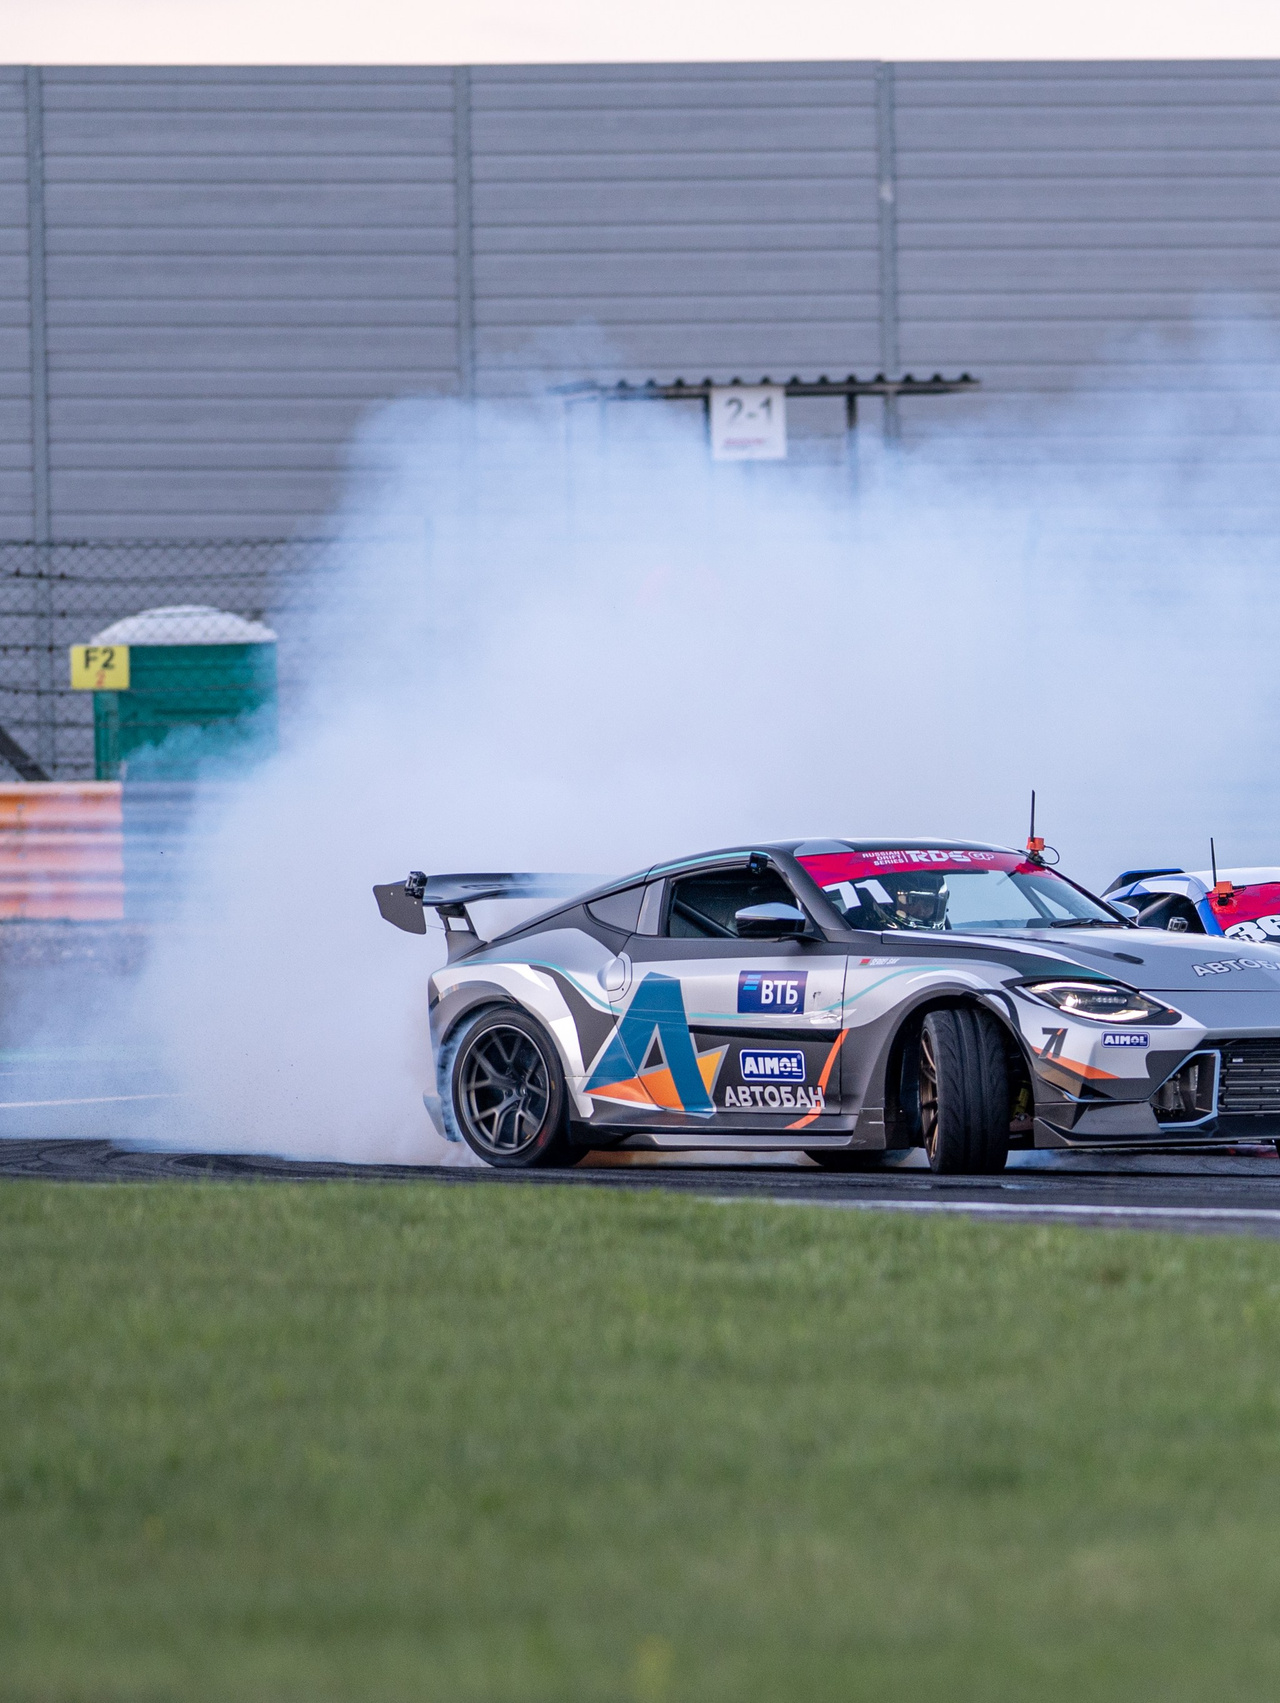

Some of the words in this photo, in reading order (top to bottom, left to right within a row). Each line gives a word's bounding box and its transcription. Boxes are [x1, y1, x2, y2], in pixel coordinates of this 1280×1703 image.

[84, 646, 116, 670] F2
[862, 850, 901, 858] RUSSIAN
[873, 858, 905, 866] SERIES
[905, 850, 972, 863] RDS
[822, 879, 894, 909] 71
[761, 980, 799, 1005] ВТБ
[1104, 1035, 1147, 1046] AIMOL
[744, 1056, 802, 1076] AIMOL
[724, 1085, 826, 1109] АВТОБАН
